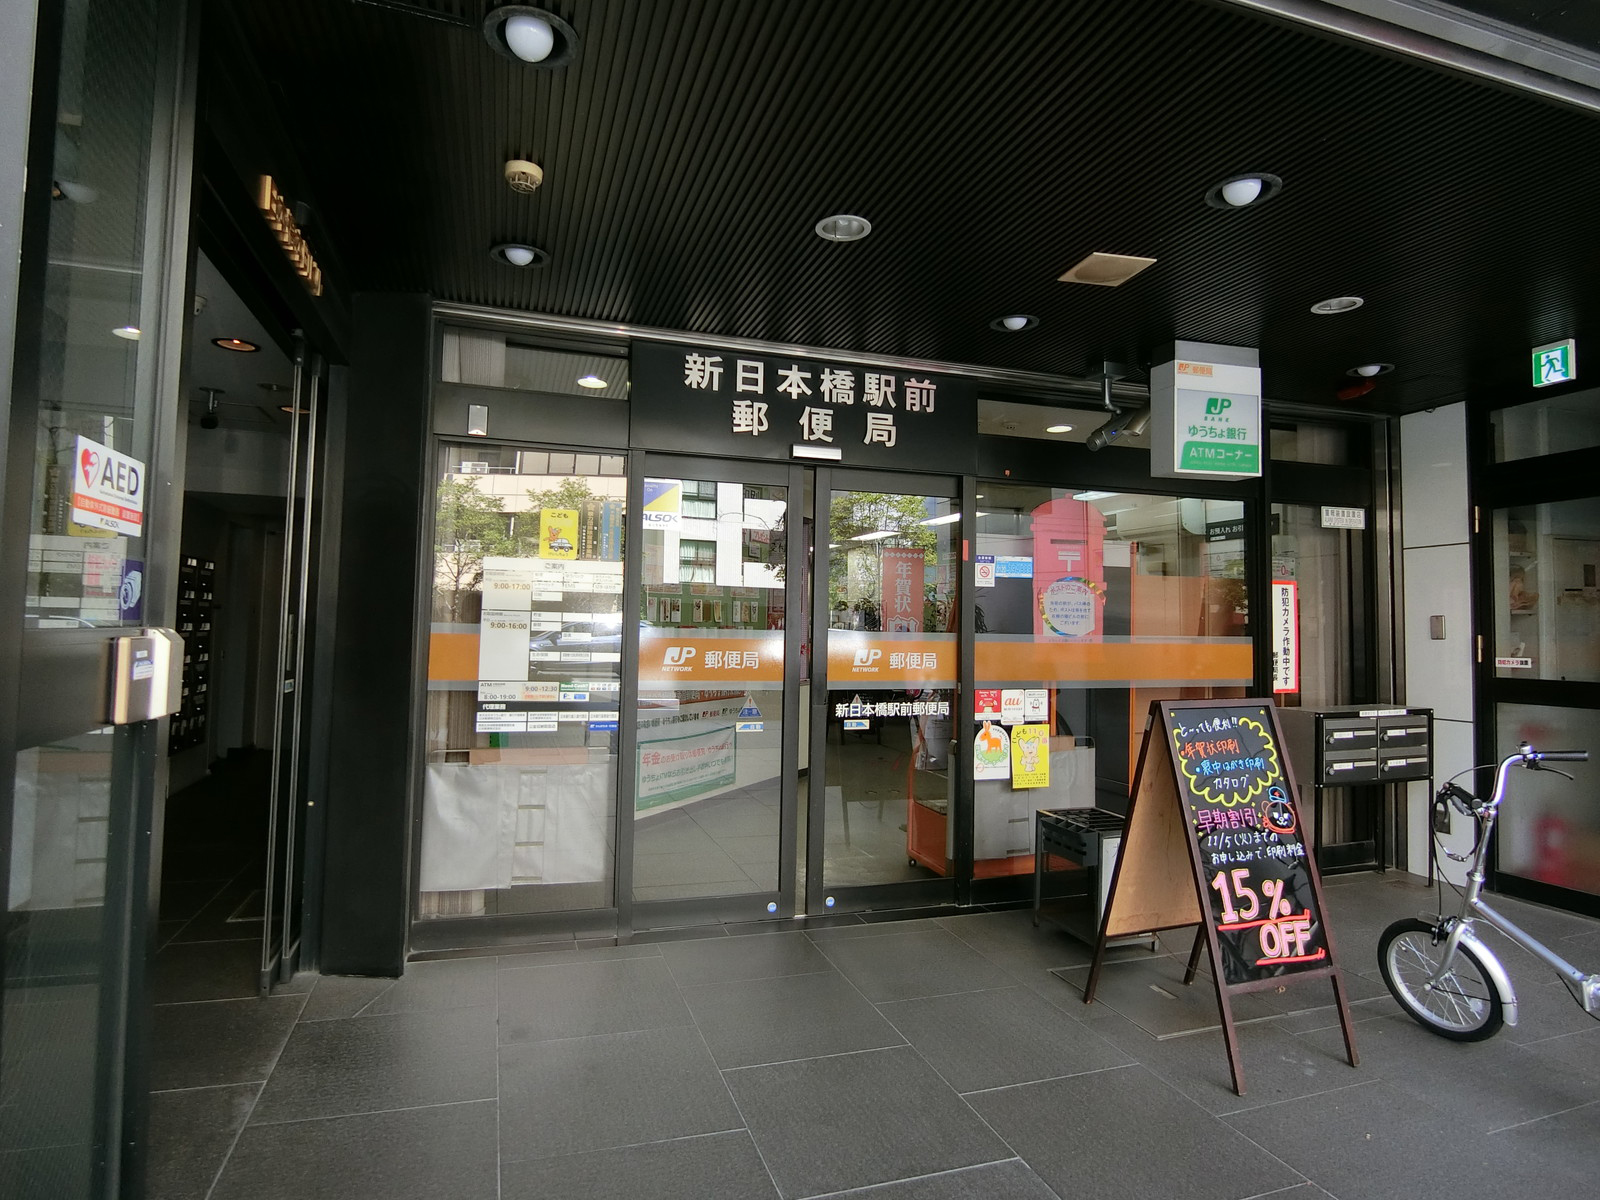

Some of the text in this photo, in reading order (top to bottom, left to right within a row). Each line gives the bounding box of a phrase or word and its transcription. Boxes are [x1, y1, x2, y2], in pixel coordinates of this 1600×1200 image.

[684, 353, 937, 413] 新日本橋駅前
[1205, 397, 1232, 415] JP
[732, 399, 897, 448] 郵便局
[1203, 415, 1230, 423] BANK
[1188, 425, 1247, 440] ゆうちょ銀行
[1189, 447, 1253, 460] ATMコーナー
[100, 457, 139, 496] AED
[544, 562, 565, 570] ご案内
[494, 582, 531, 590] 9:00-17:00
[894, 562, 912, 613] 年賀状
[490, 622, 527, 630] 9:00-16:00
[1281, 587, 1290, 686] 防犯カメラ作動中です
[663, 647, 697, 665] JP
[704, 651, 759, 670] 郵便局
[853, 648, 882, 666] JP
[889, 652, 937, 669] 郵便局
[835, 701, 950, 717] 新日本橋駅前郵便局
[1004, 697, 1022, 706] au
[1213, 774, 1250, 790] カタログ
[1197, 808, 1258, 834] 早期割引
[1260, 920, 1311, 958] OFF
